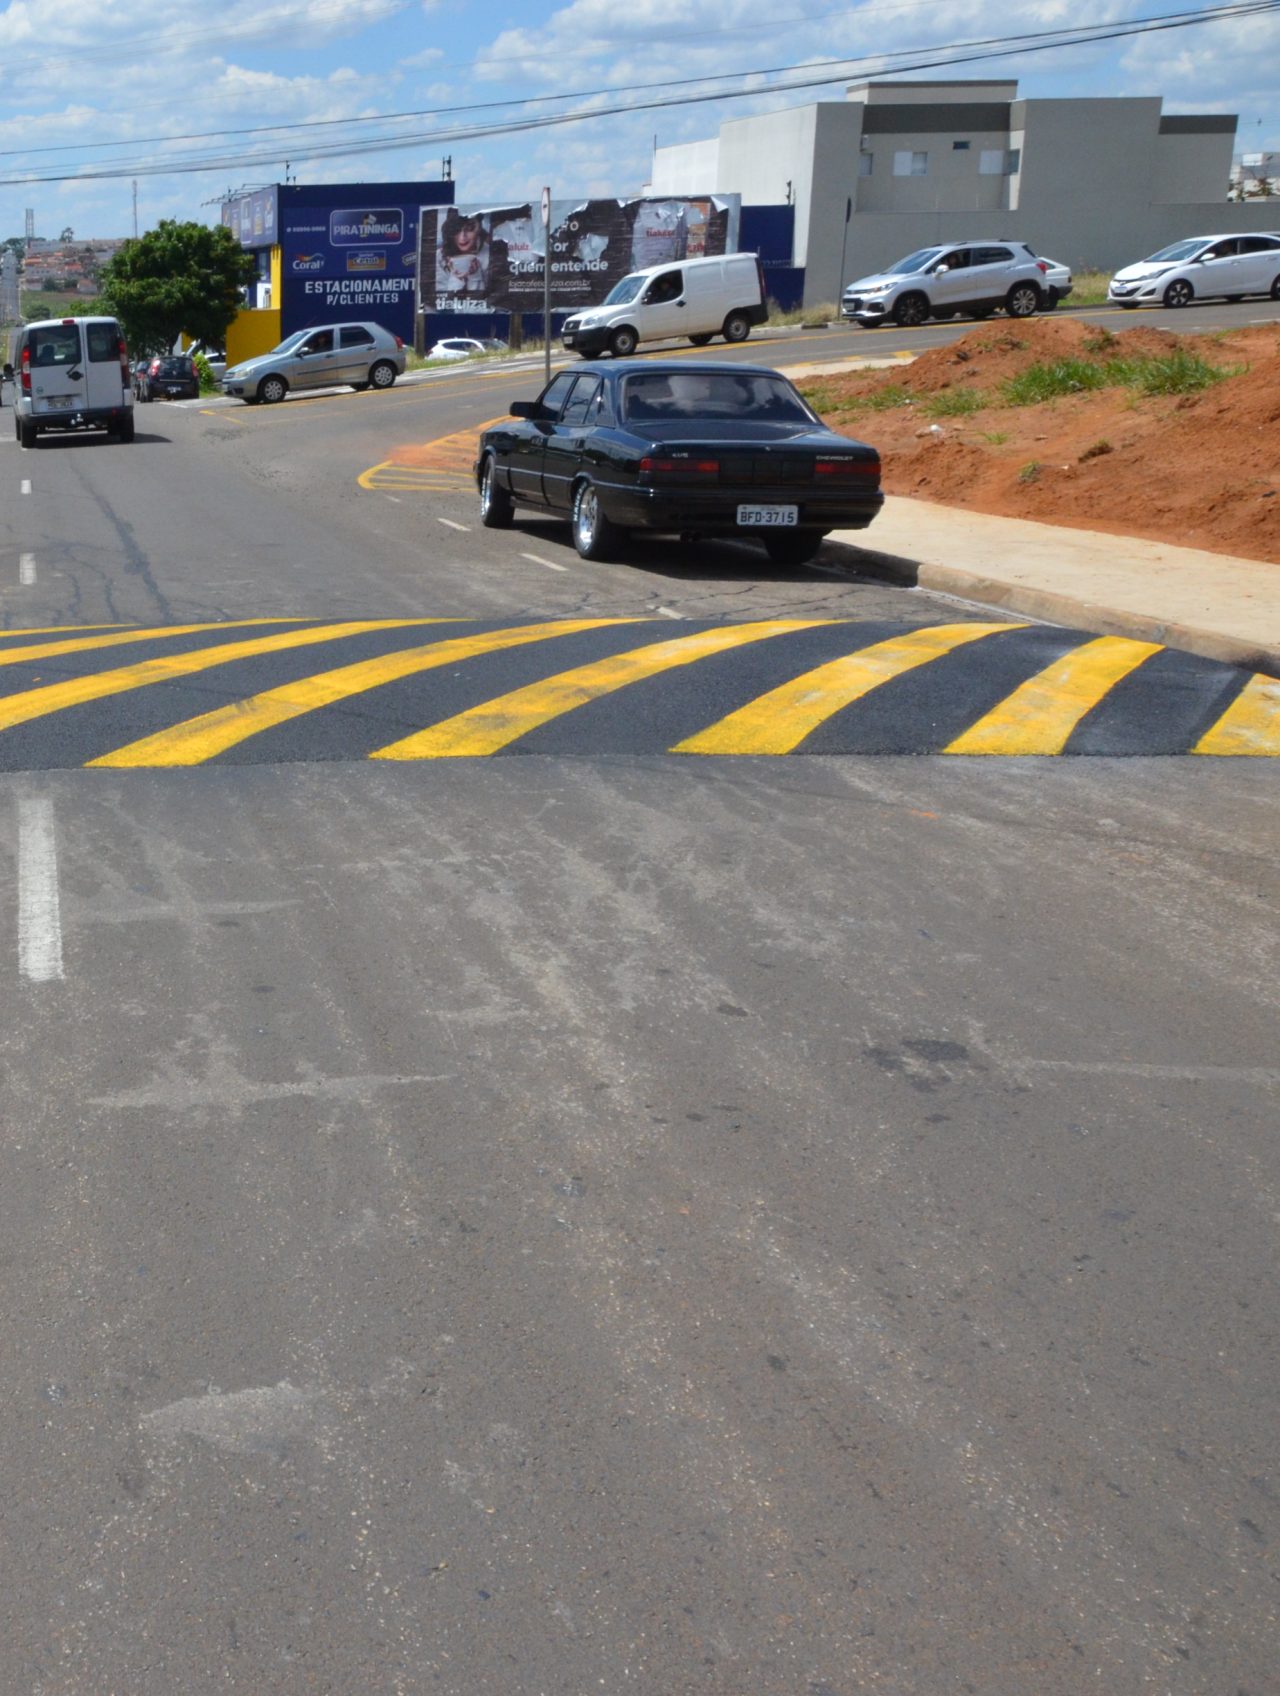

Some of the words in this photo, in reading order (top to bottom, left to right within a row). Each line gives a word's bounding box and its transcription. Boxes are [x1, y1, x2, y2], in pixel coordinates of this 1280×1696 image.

[333, 223, 399, 236] PIRATININGA
[292, 259, 320, 270] Coral
[551, 259, 609, 272] entende
[326, 293, 399, 305] P/CLIENTES
[435, 297, 487, 311] tialuiza
[740, 511, 795, 523] BFD-3715
